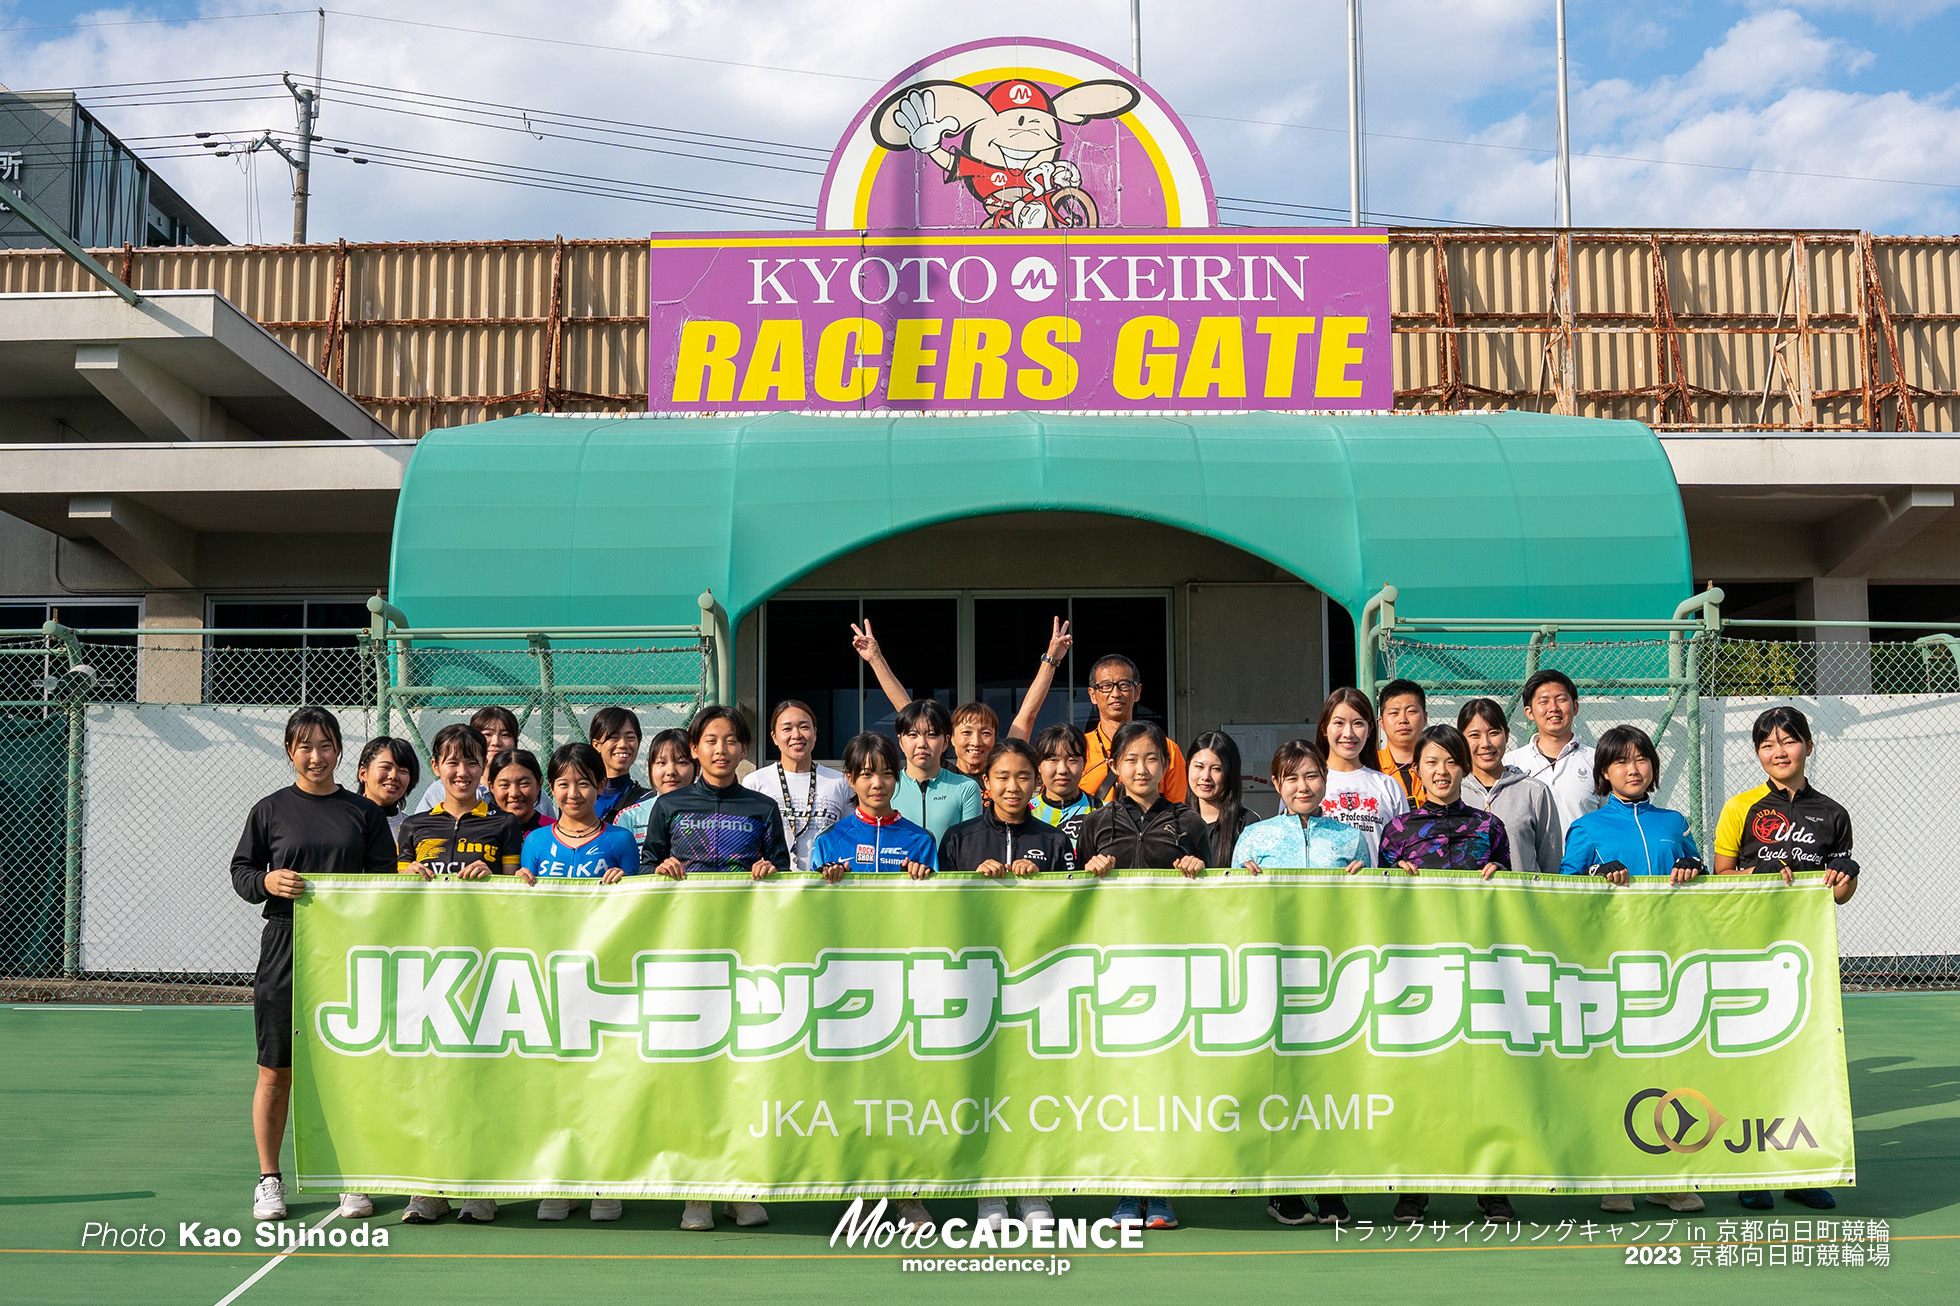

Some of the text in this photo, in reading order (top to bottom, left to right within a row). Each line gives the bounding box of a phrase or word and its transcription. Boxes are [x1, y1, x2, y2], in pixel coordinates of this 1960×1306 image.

[747, 256, 998, 305] KYOTO
[1072, 256, 1310, 303] KEIRIN
[672, 316, 1368, 402] RACERS GATE
[1340, 812, 1384, 825] Professional
[1756, 808, 1777, 819] UDA
[680, 820, 753, 832] SHIMANO
[1774, 822, 1816, 844] Uda
[1757, 846, 1788, 861] Cycle
[1791, 847, 1823, 865] Racing
[539, 858, 609, 878] SEIKA
[320, 948, 1810, 1059] JKAトラックサイクリングキャンプ
[749, 1093, 1395, 1139] JKA TRACK CYCLING CAMP
[1724, 1117, 1819, 1153] JKA
